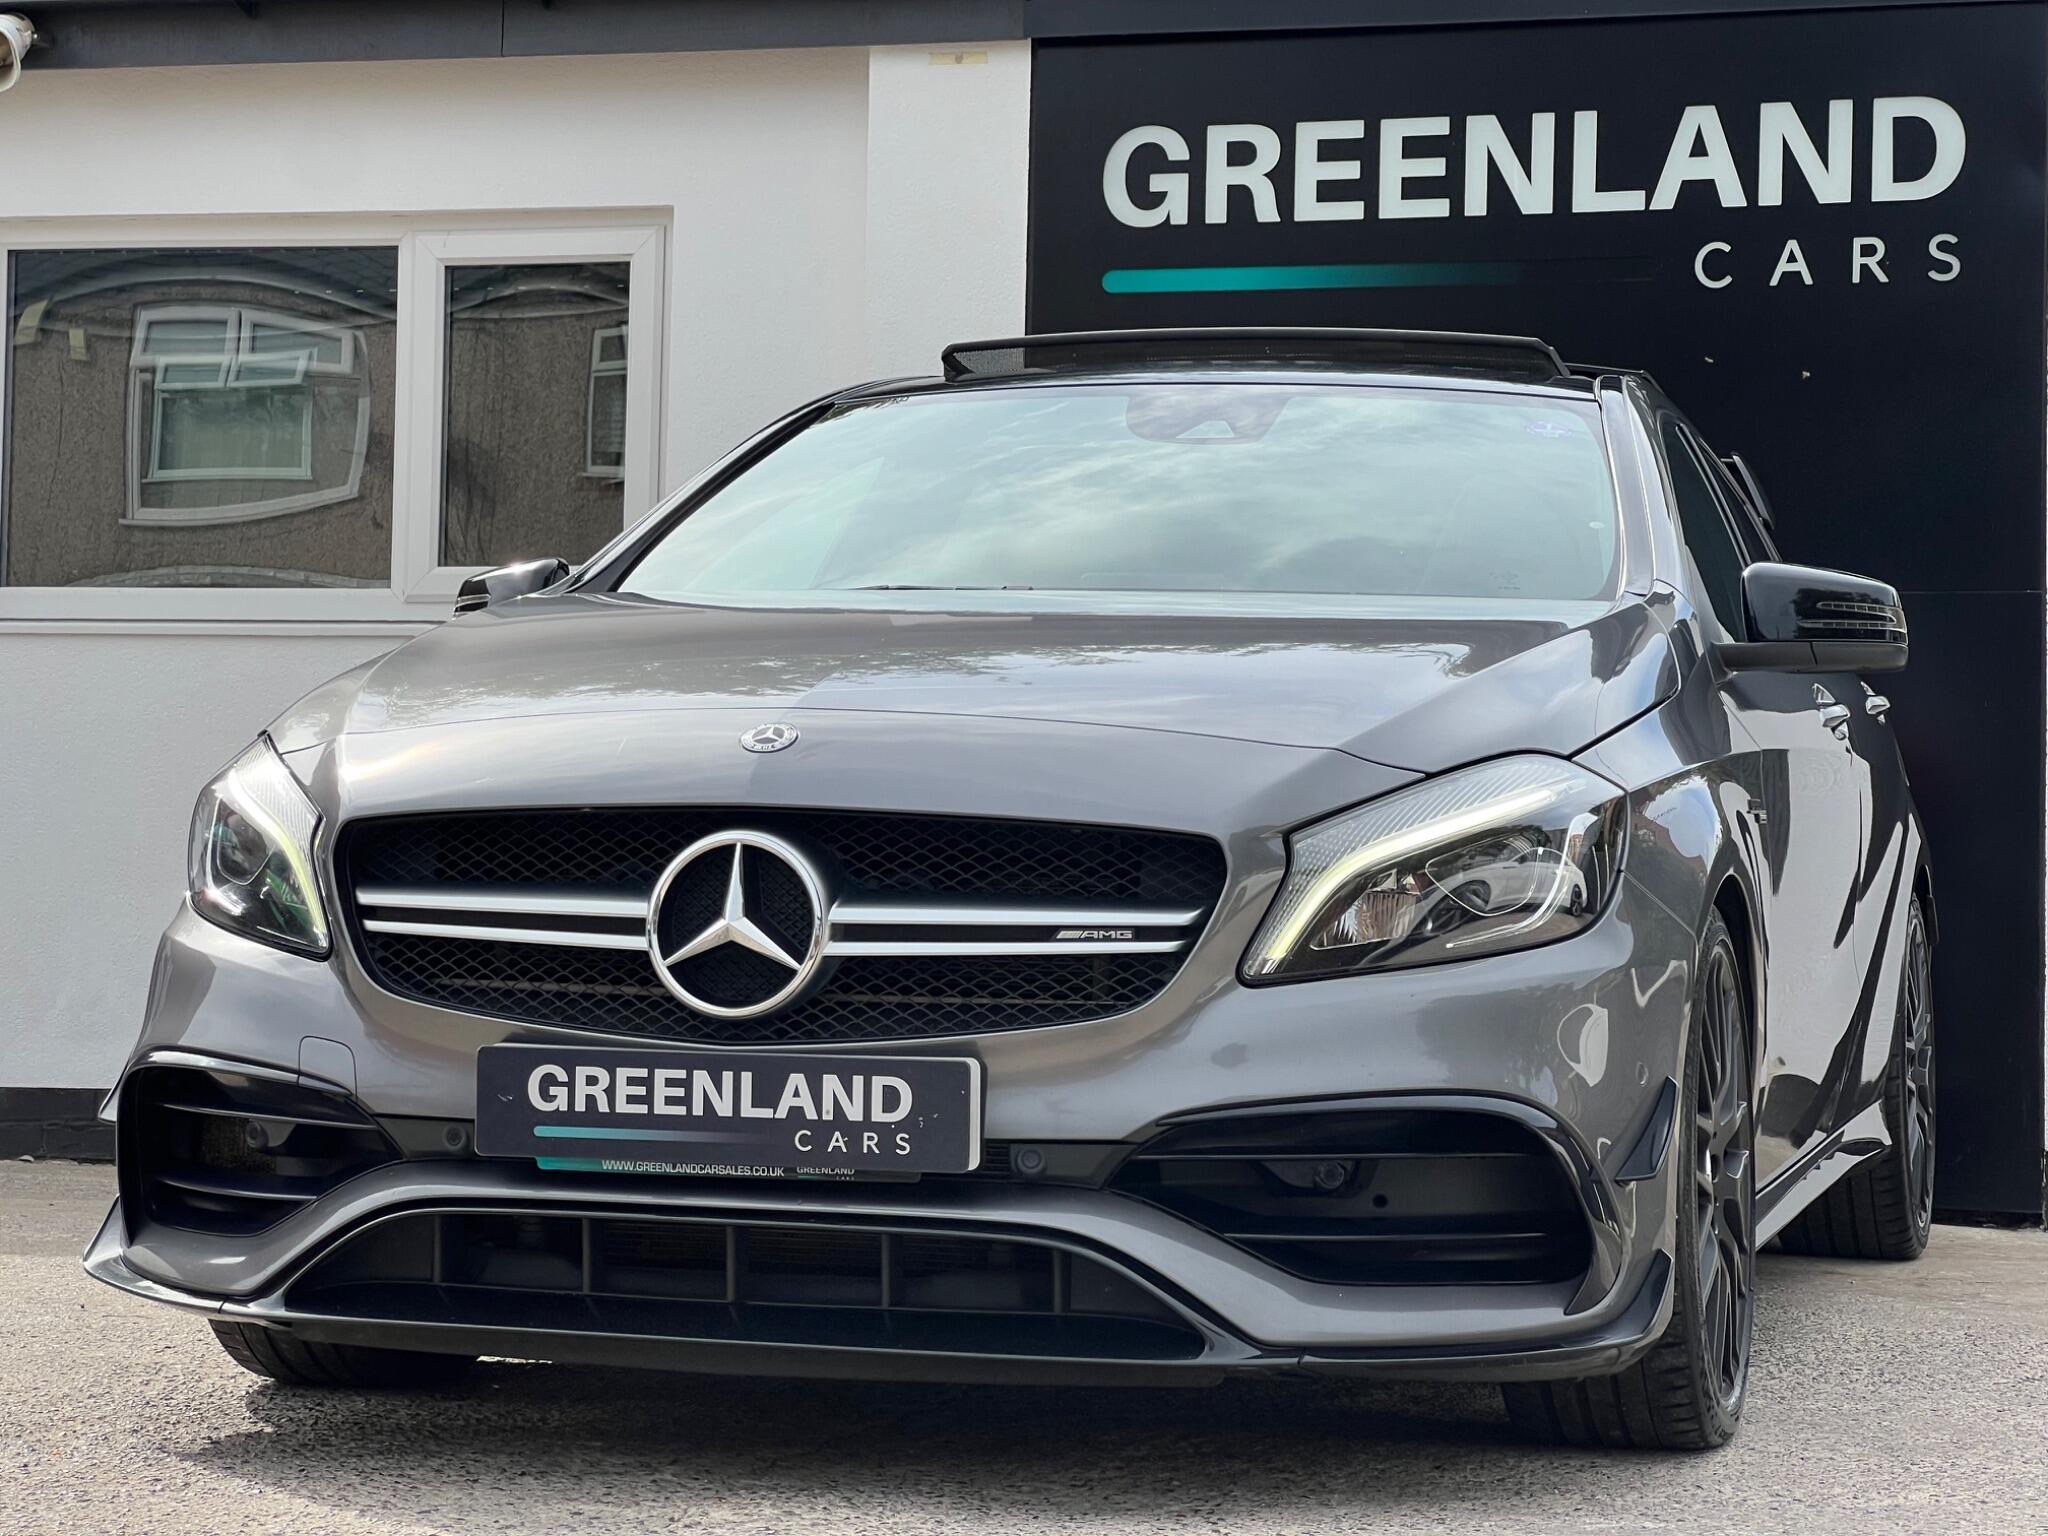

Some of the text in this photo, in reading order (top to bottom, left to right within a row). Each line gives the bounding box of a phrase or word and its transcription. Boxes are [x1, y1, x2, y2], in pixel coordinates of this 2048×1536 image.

[1102, 96, 1966, 228] GREENLAND
[1694, 233, 1961, 289] CARS
[1080, 930, 1133, 939] AMG
[527, 1063, 913, 1124] GREENLAND
[794, 1129, 911, 1155] CARS
[601, 1159, 785, 1177] WWW.GREENLANDCARSALES.CO.UK
